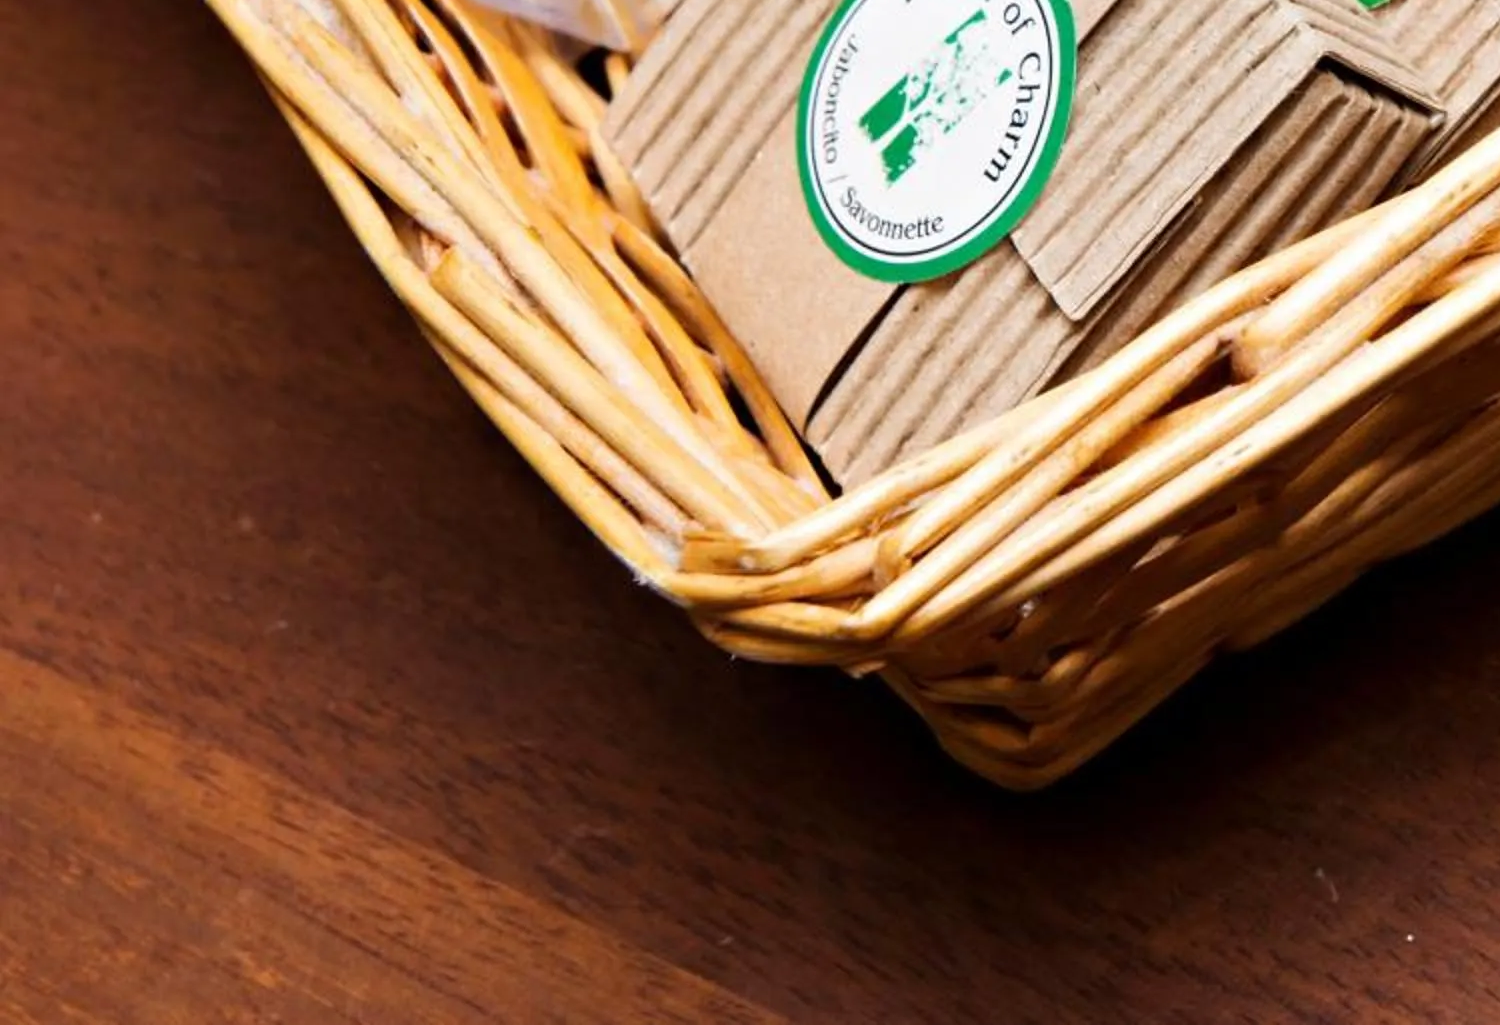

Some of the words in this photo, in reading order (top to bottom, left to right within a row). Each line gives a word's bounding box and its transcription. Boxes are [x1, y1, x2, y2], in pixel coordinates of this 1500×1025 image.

[1003, 2, 1037, 35] of
[823, 33, 859, 165] Jaboncito
[983, 51, 1041, 183] Charm
[840, 186, 944, 240] Savonnette
